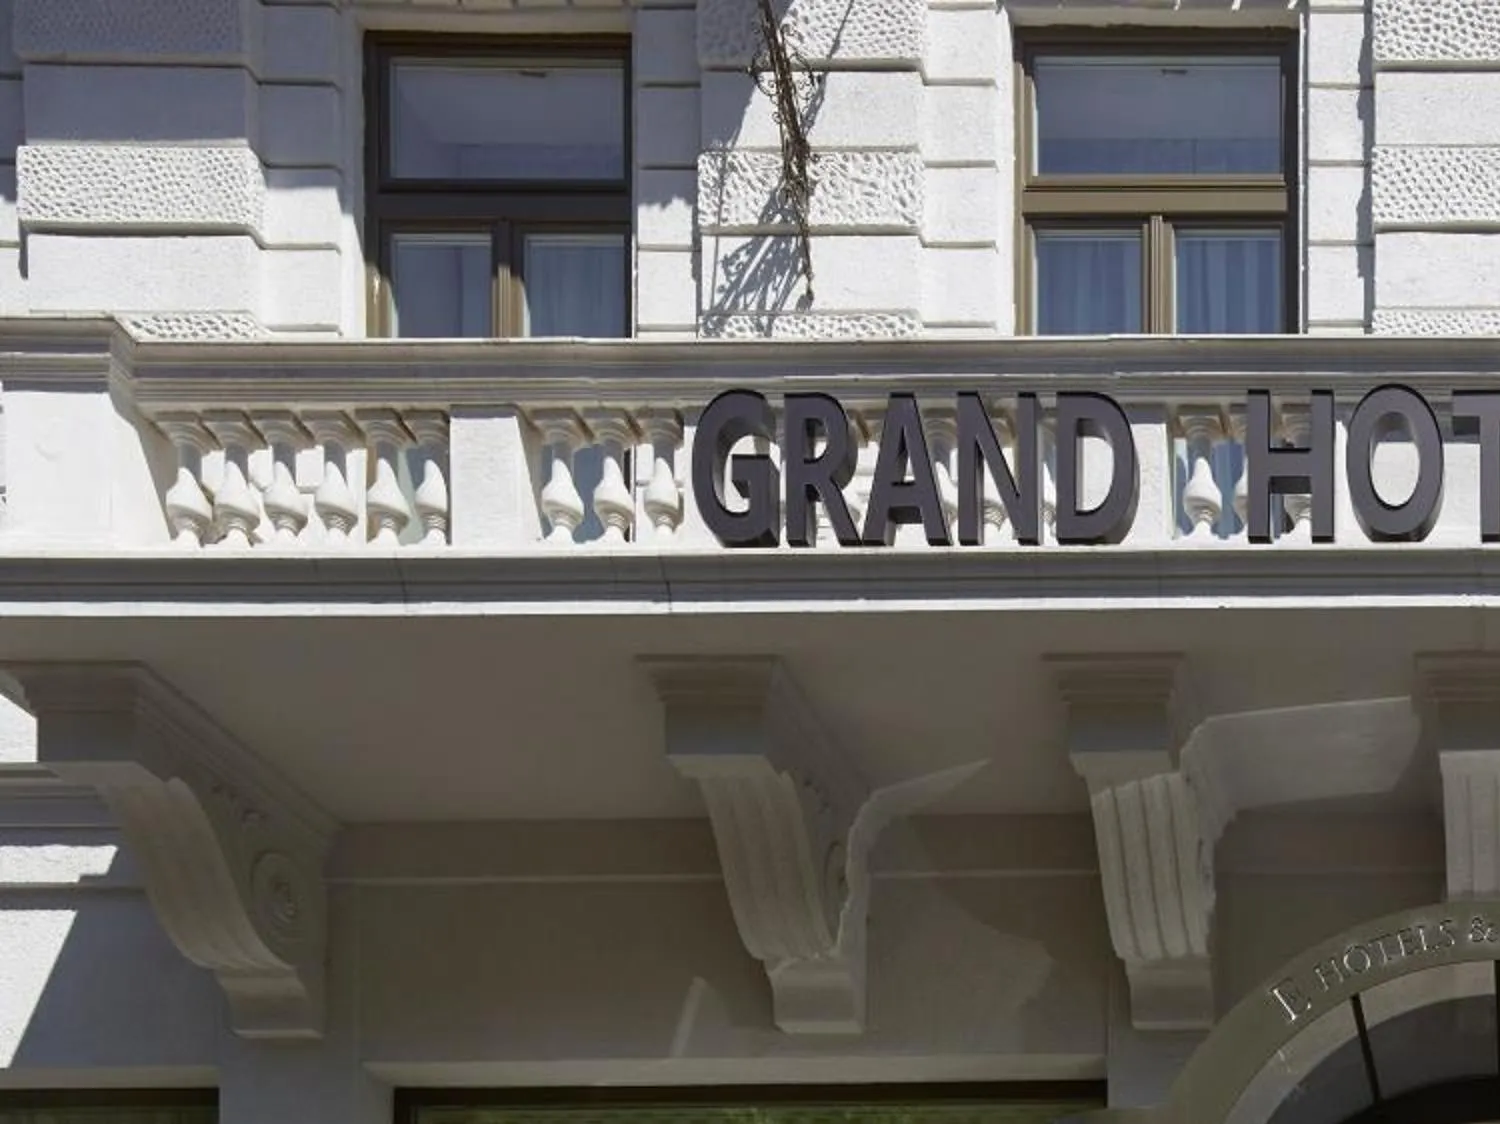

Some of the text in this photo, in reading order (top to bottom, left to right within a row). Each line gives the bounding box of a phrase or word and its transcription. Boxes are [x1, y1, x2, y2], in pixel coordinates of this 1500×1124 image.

[692, 388, 1140, 547] GRAND
[1314, 919, 1456, 992] HOTELS
[1468, 916, 1499, 943] &
